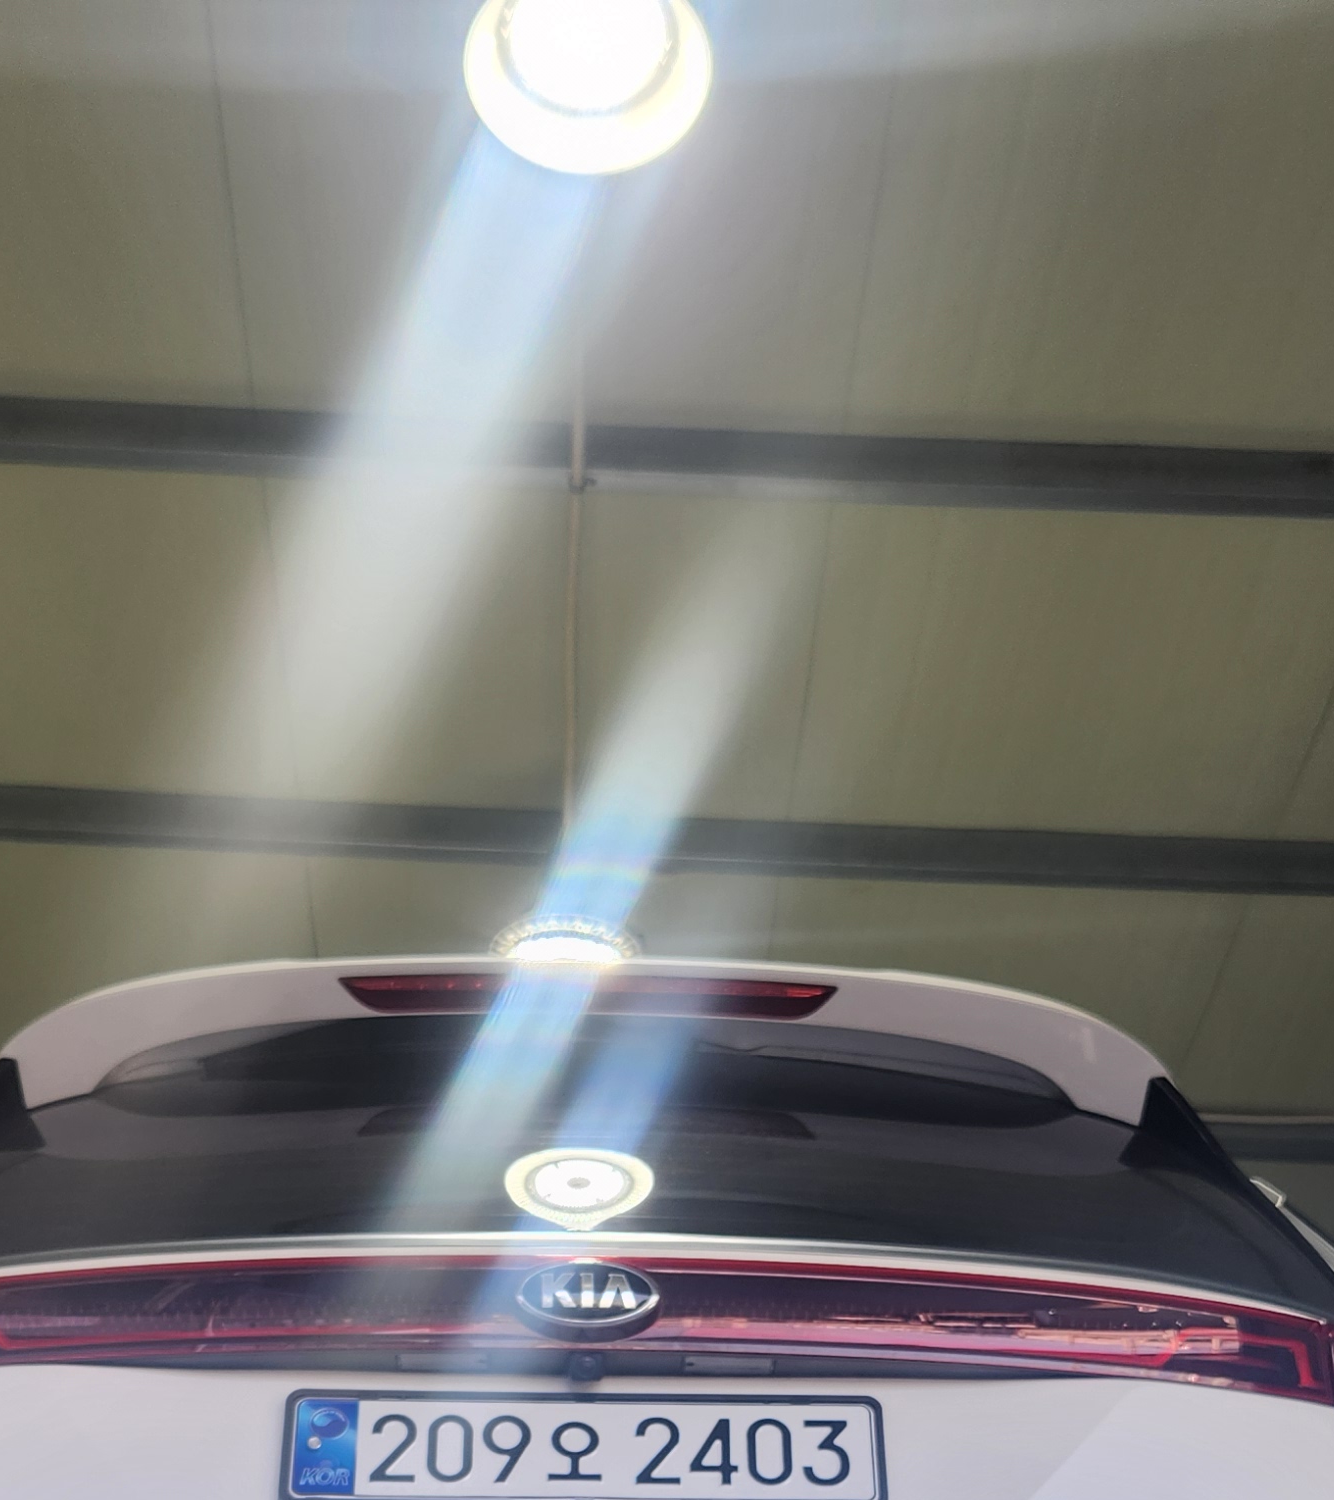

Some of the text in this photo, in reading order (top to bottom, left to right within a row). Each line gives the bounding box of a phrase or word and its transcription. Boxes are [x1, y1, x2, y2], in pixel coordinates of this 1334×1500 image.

[540, 1272, 637, 1309] KIA
[368, 1413, 851, 1487] 209오 2403
[299, 1467, 350, 1486] KOR
